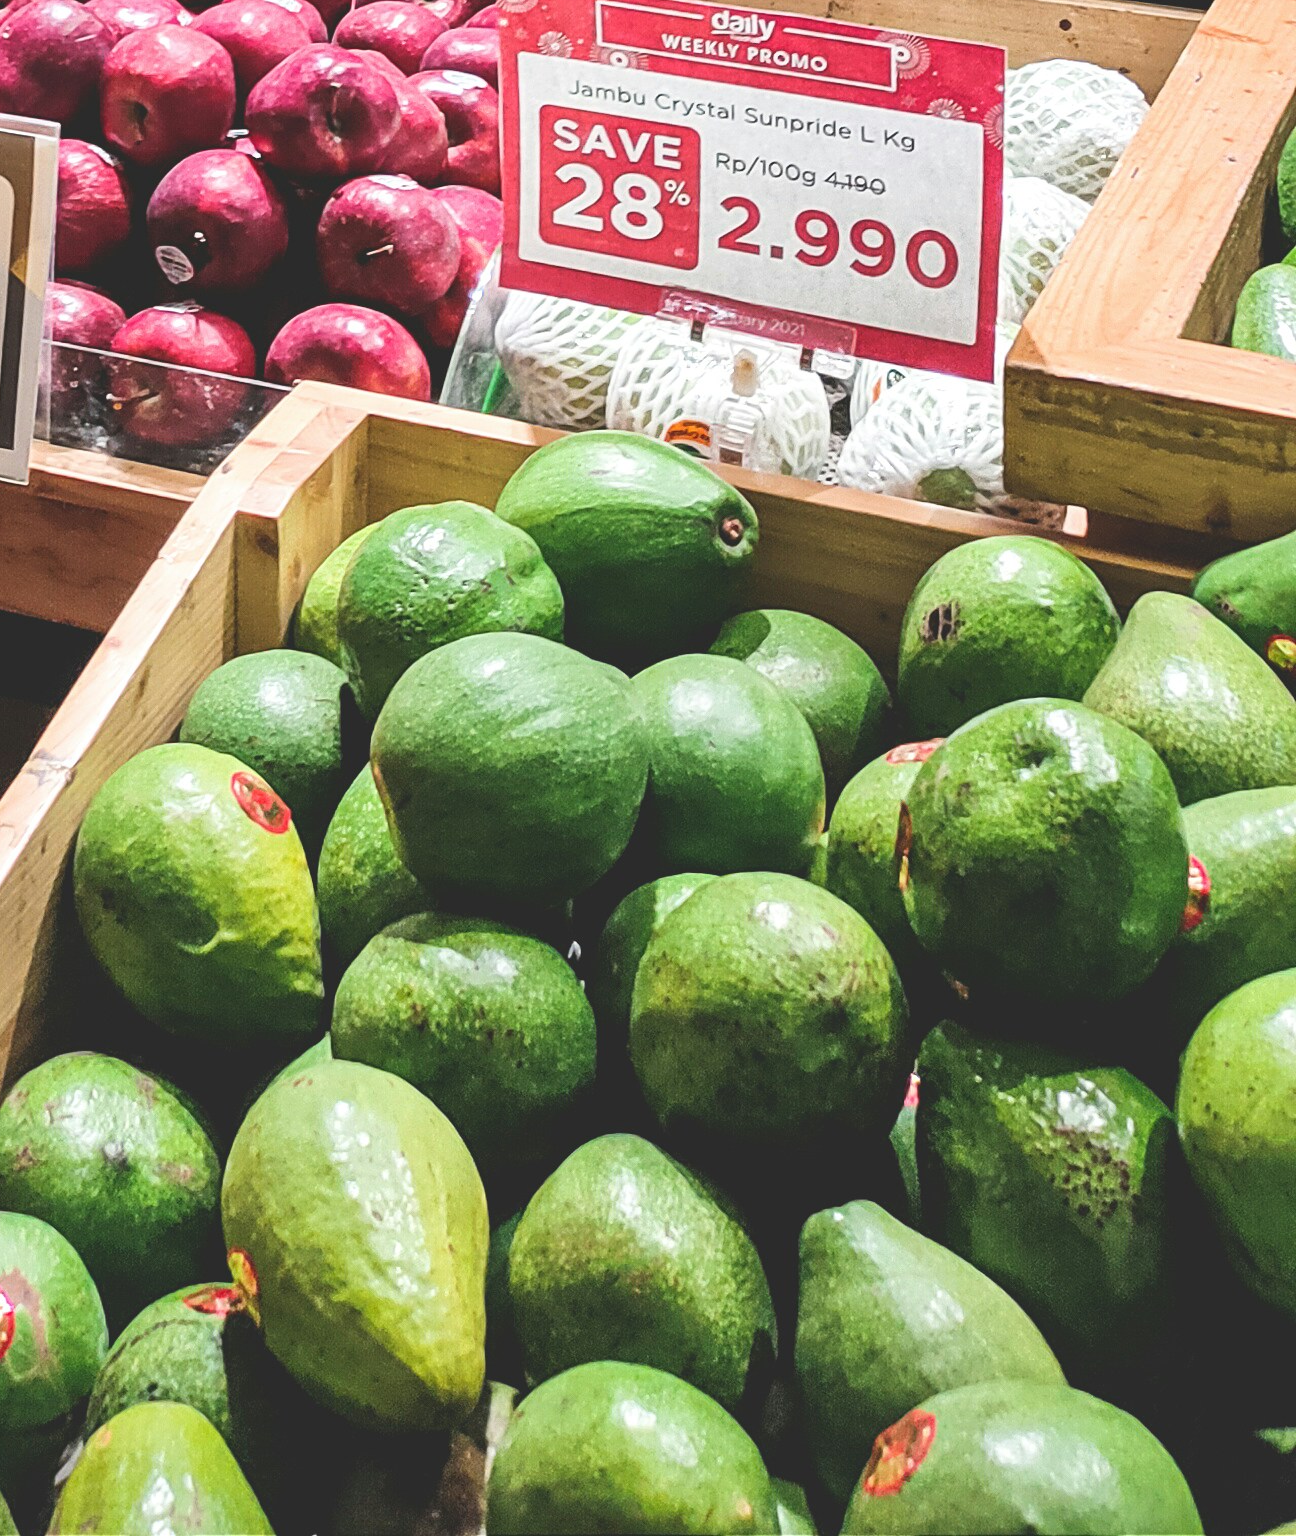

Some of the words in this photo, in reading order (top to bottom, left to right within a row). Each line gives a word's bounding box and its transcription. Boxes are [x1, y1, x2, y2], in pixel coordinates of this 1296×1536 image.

[711, 9, 776, 42] daily
[661, 33, 741, 61] WEEKLY
[746, 45, 828, 73] PROMO
[568, 79, 646, 107] Jambu
[655, 92, 736, 122] Crystal
[744, 106, 852, 139] Sunpride
[860, 125, 875, 144] L
[884, 131, 916, 153] Kg
[552, 119, 682, 170] SAVE
[715, 152, 817, 188] Rp/100g
[717, 195, 960, 289] 2.990
[770, 318, 806, 337] 2021
